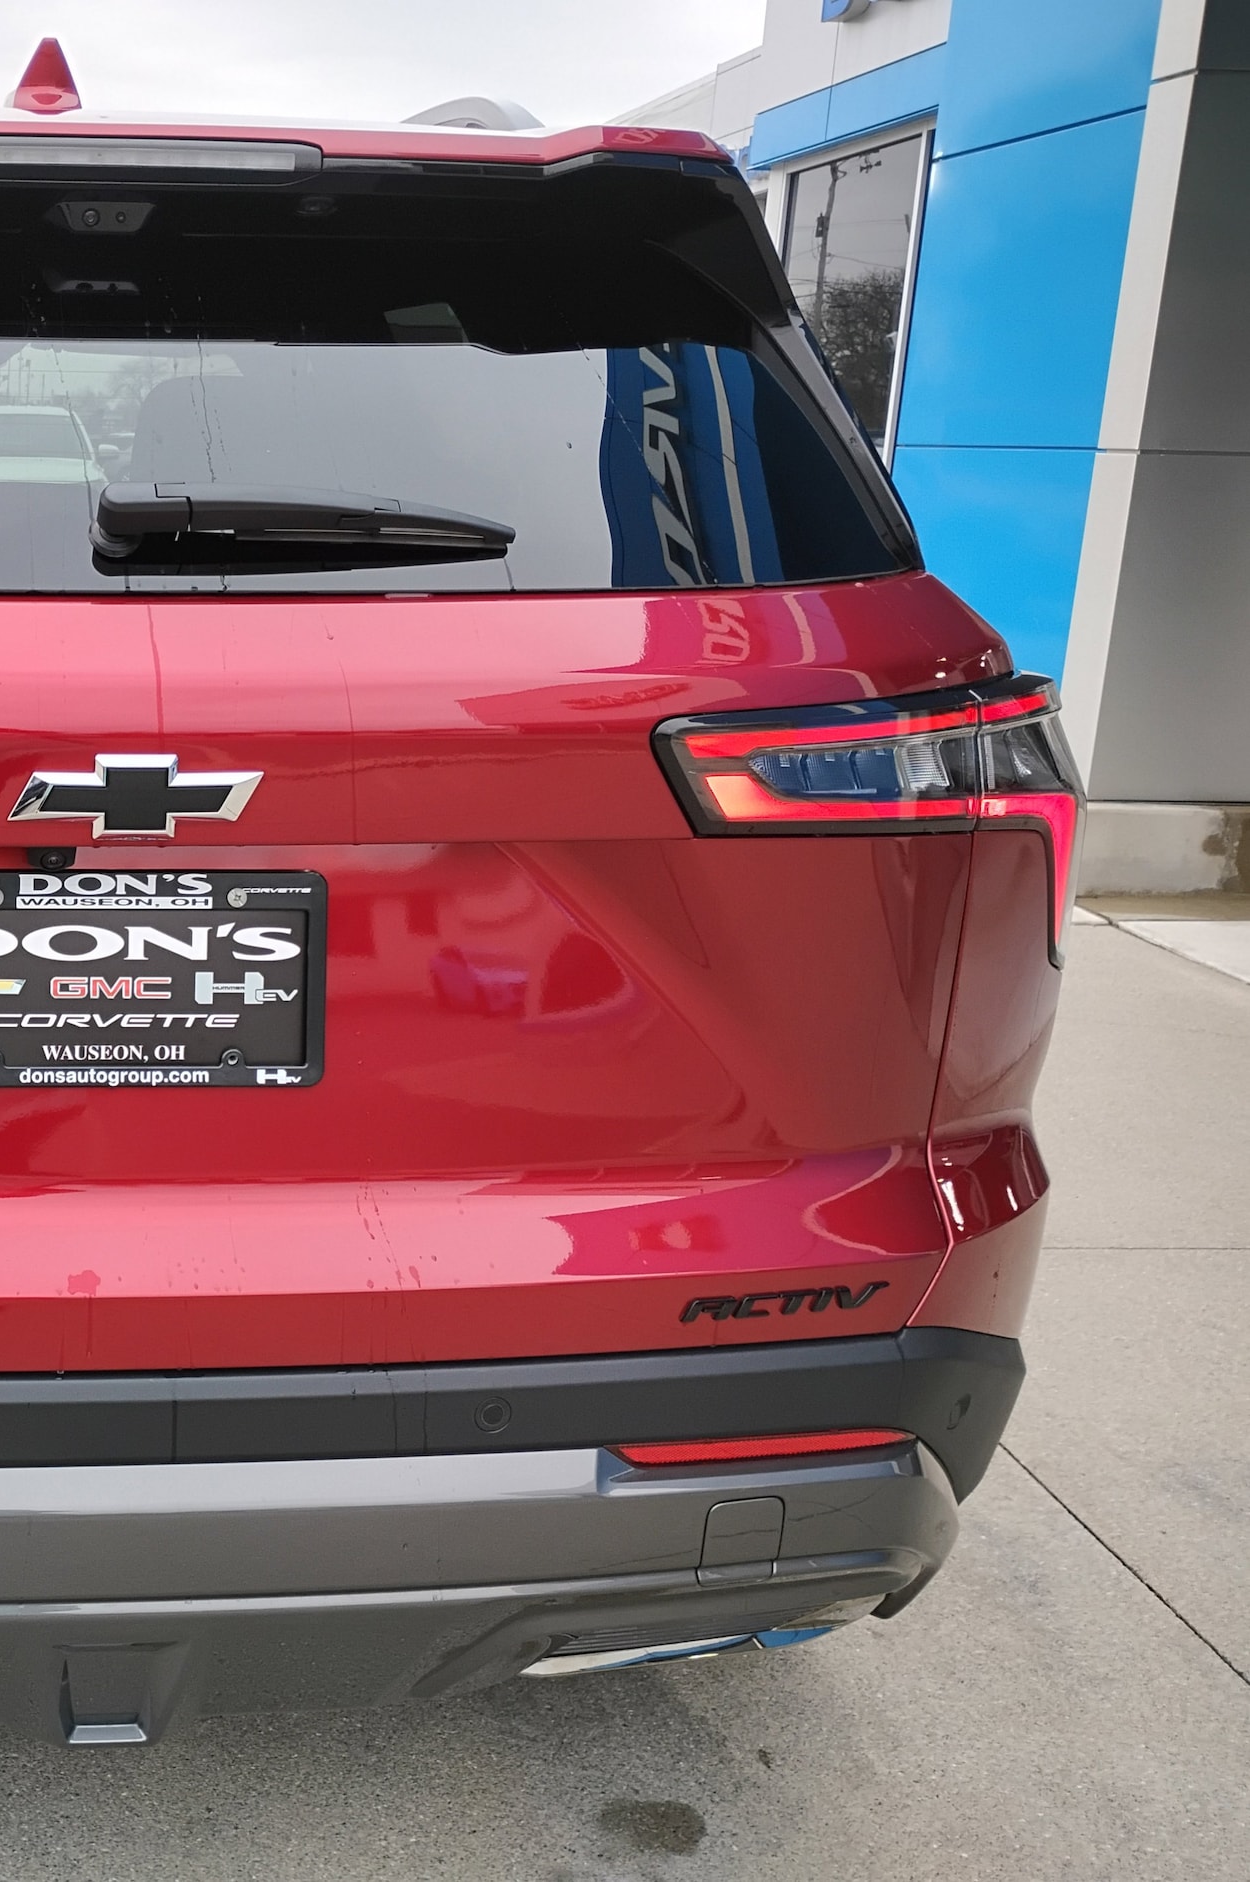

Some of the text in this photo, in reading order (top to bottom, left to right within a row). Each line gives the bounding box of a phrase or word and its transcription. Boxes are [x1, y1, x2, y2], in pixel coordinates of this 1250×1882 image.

[17, 872, 213, 896] DON'S
[19, 898, 210, 908] WAUSEON, OH
[50, 976, 173, 1000] GMC
[42, 1045, 185, 1063] WAUSEON, OH
[19, 1069, 210, 1086] donsautogroup.com
[679, 1280, 890, 1323] ACTIV
